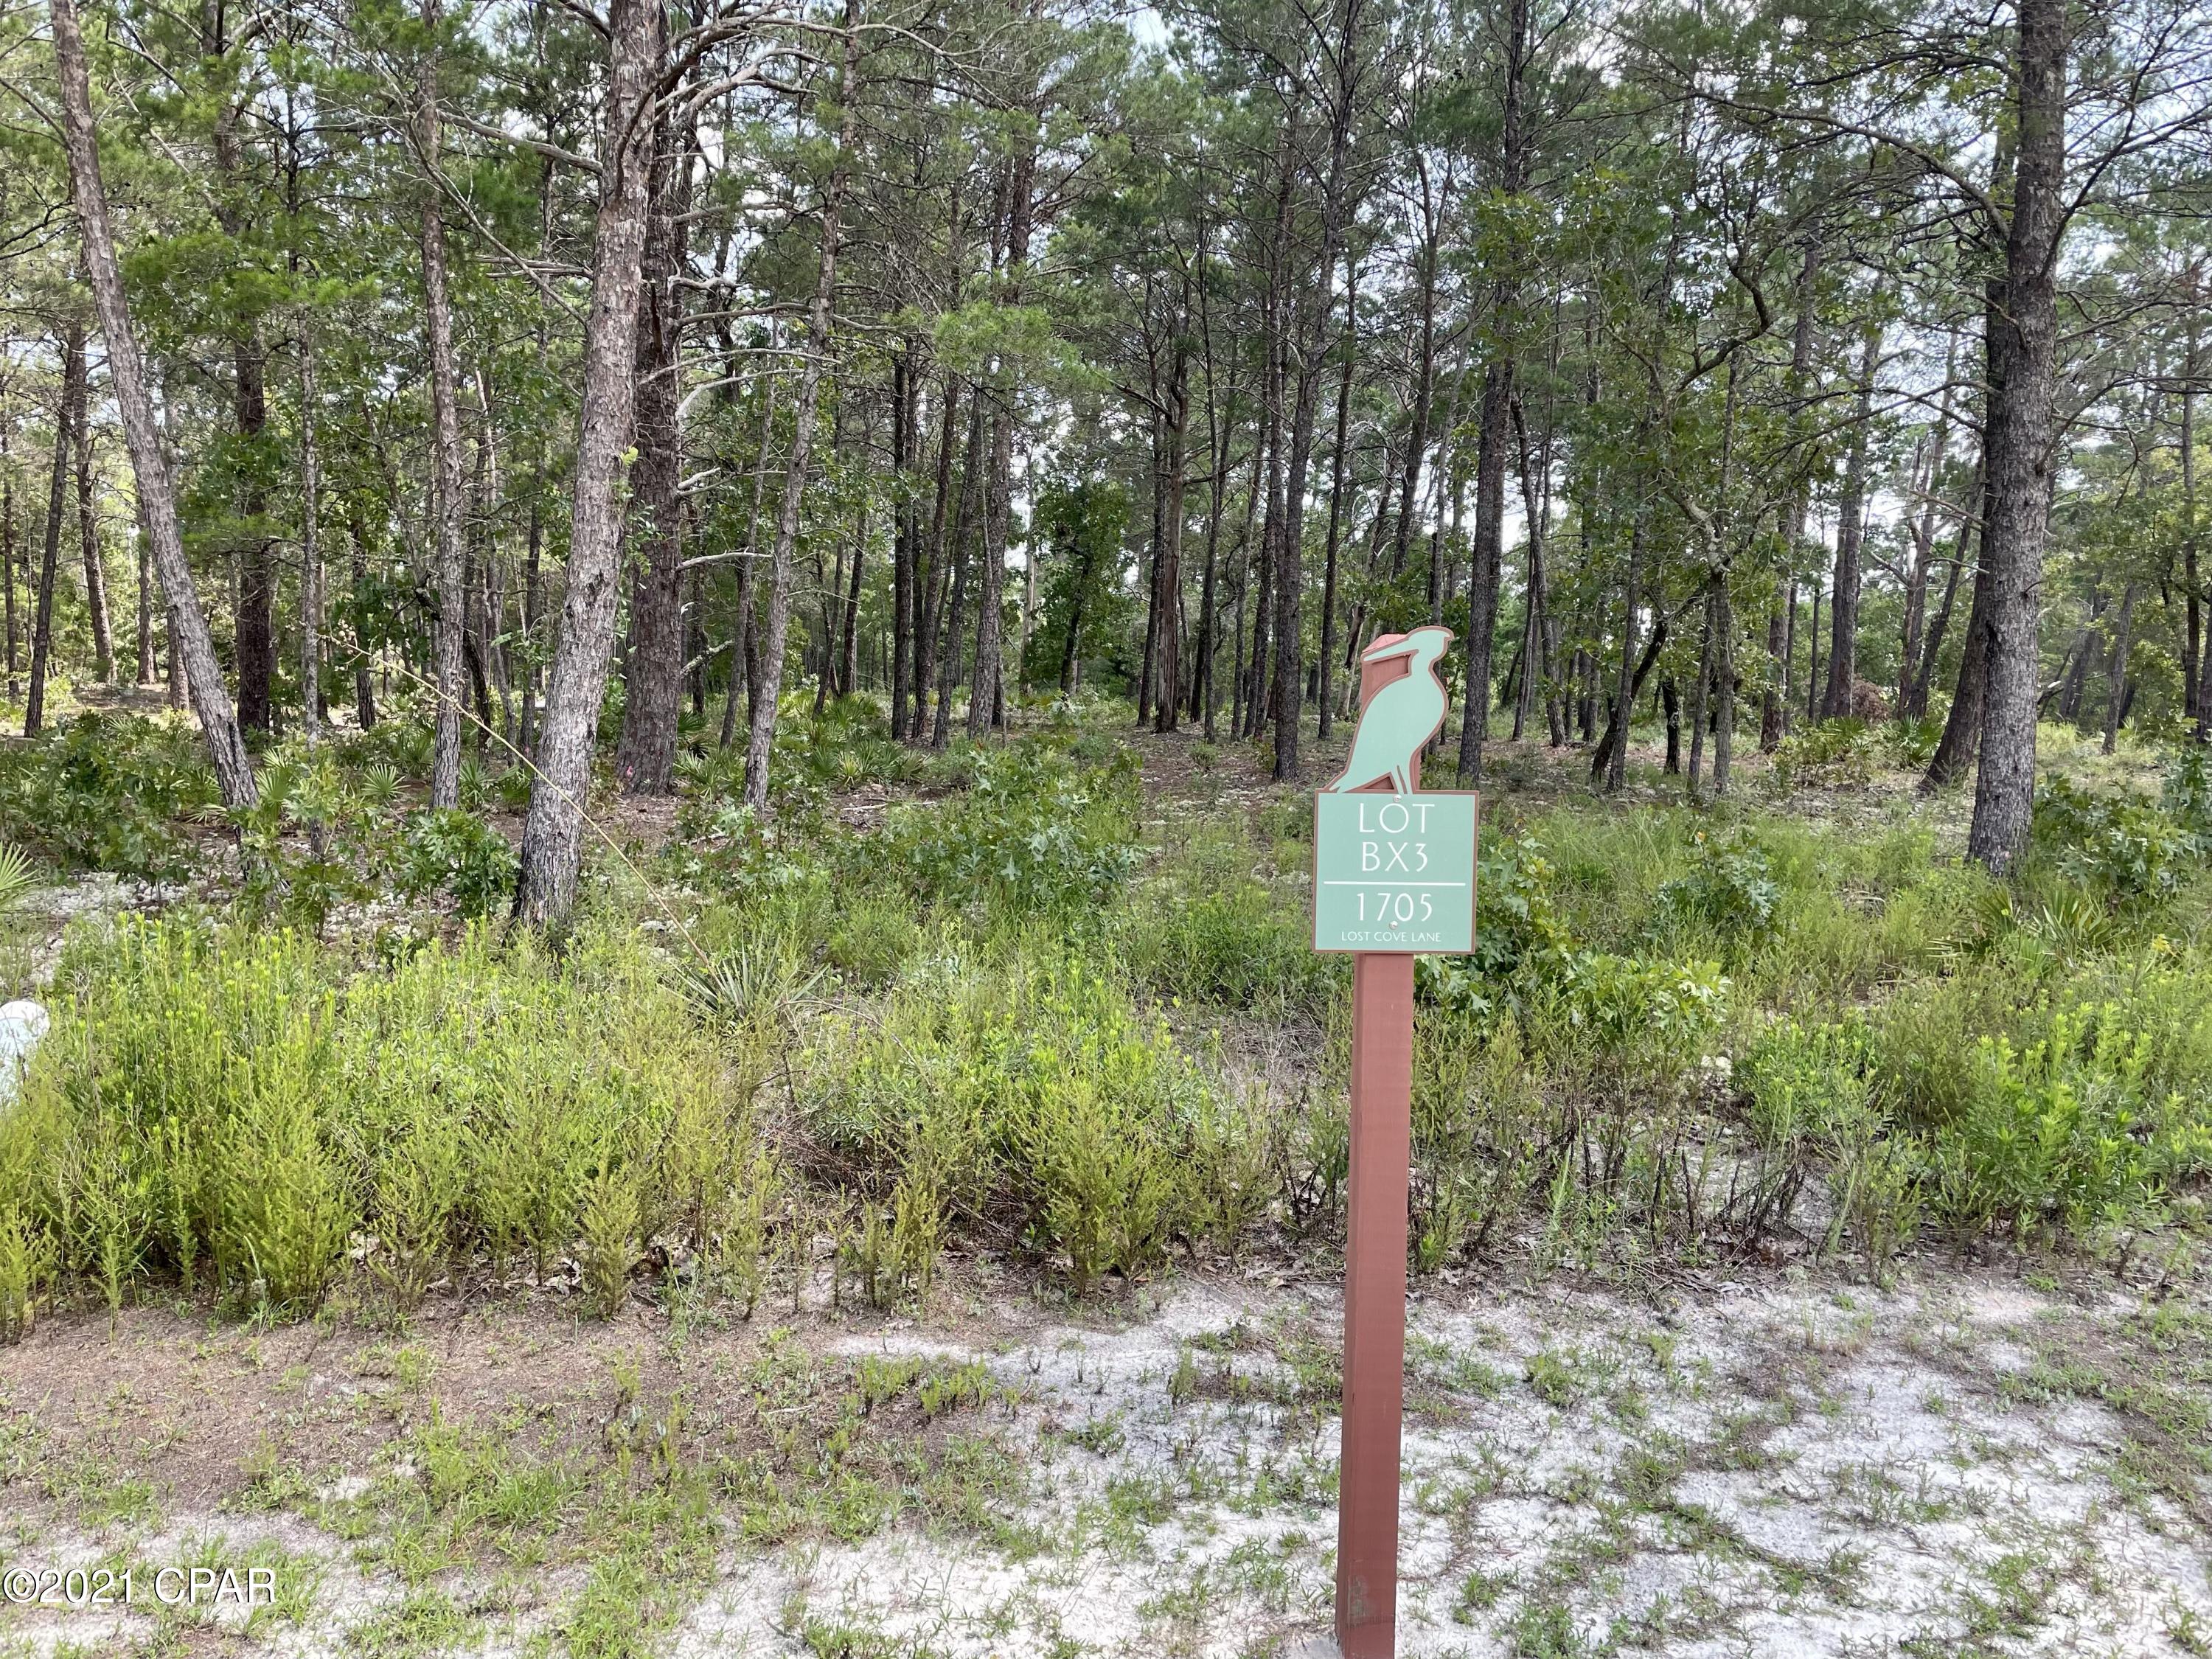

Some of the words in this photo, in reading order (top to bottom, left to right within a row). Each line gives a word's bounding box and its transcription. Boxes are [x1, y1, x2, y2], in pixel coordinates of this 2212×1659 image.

[1359, 802, 1435, 833] LOT
[1362, 841, 1428, 872] BX3
[1357, 892, 1433, 922] 1705
[1341, 931, 1370, 942] LOST
[1374, 931, 1408, 942] COVE
[1411, 932, 1441, 942] LANE
